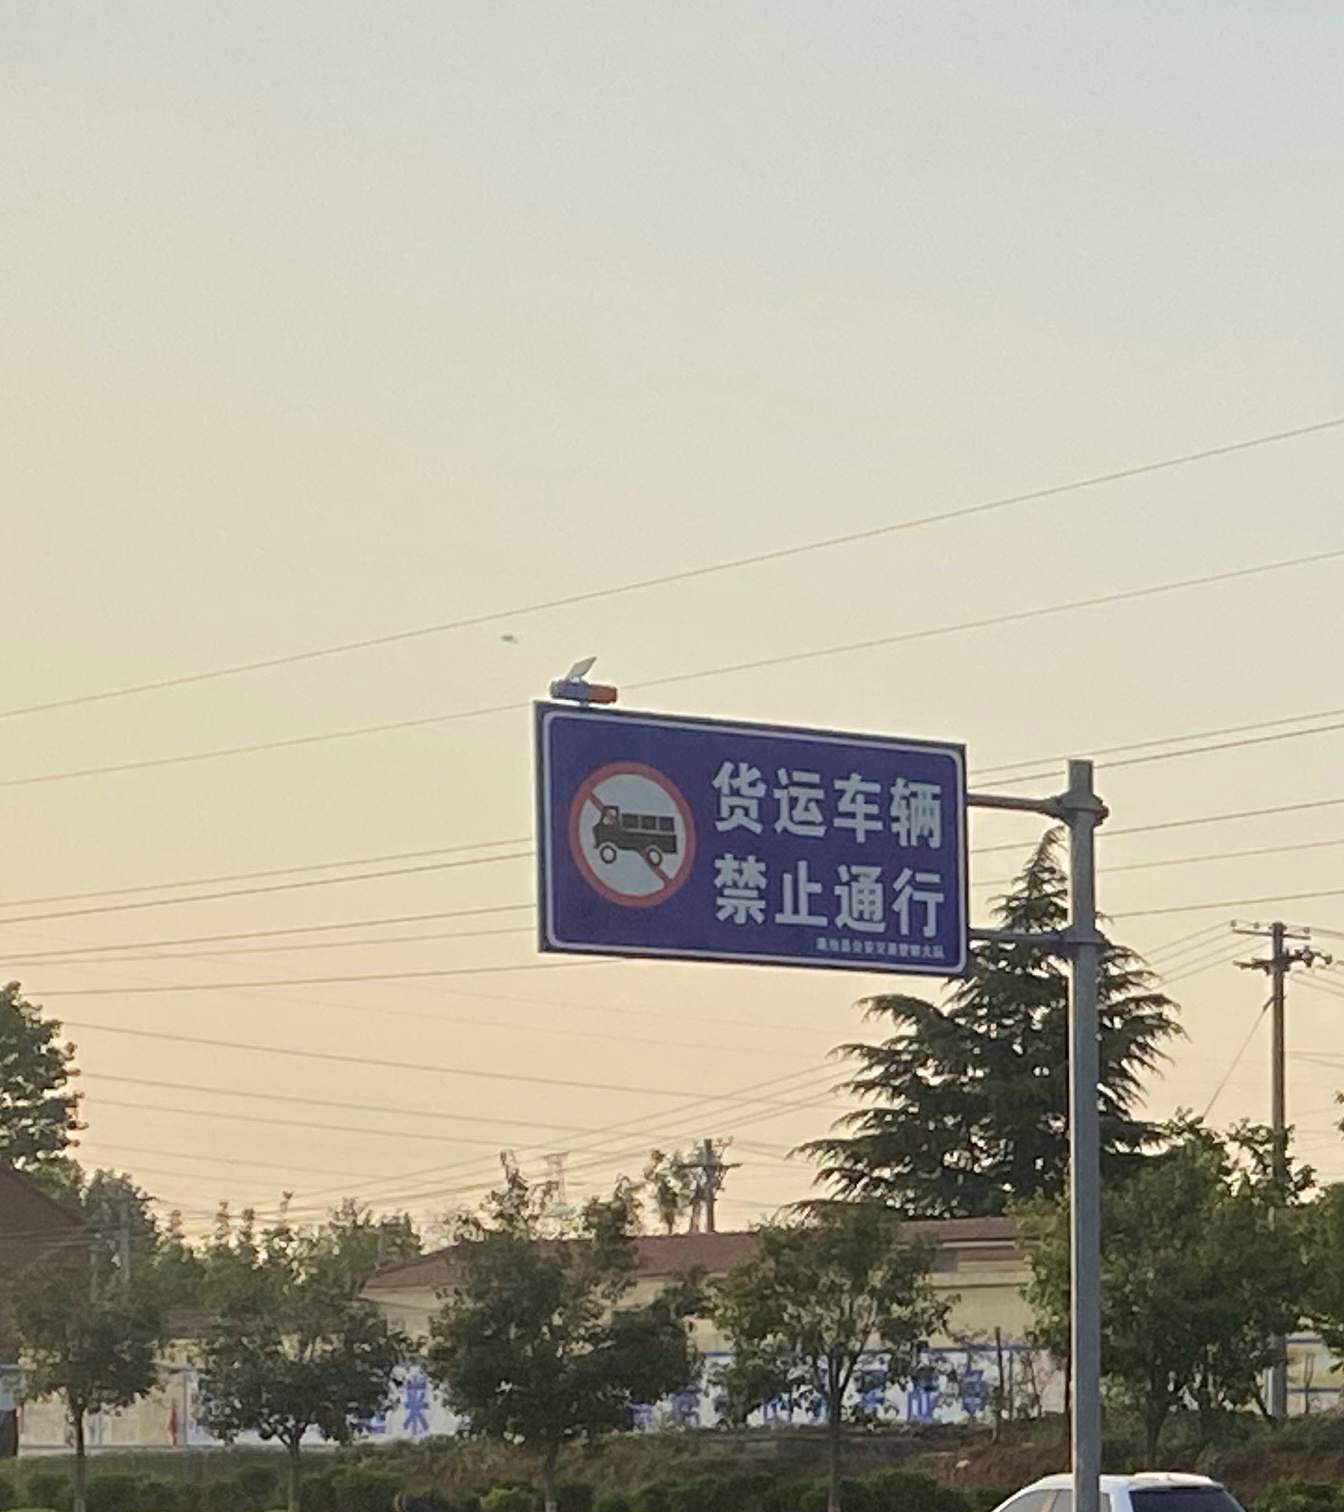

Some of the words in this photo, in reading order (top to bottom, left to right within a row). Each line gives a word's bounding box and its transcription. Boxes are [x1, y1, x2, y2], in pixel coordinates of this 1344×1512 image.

[713, 761, 942, 848] 货运车辆
[713, 853, 945, 937] 禁止通行
